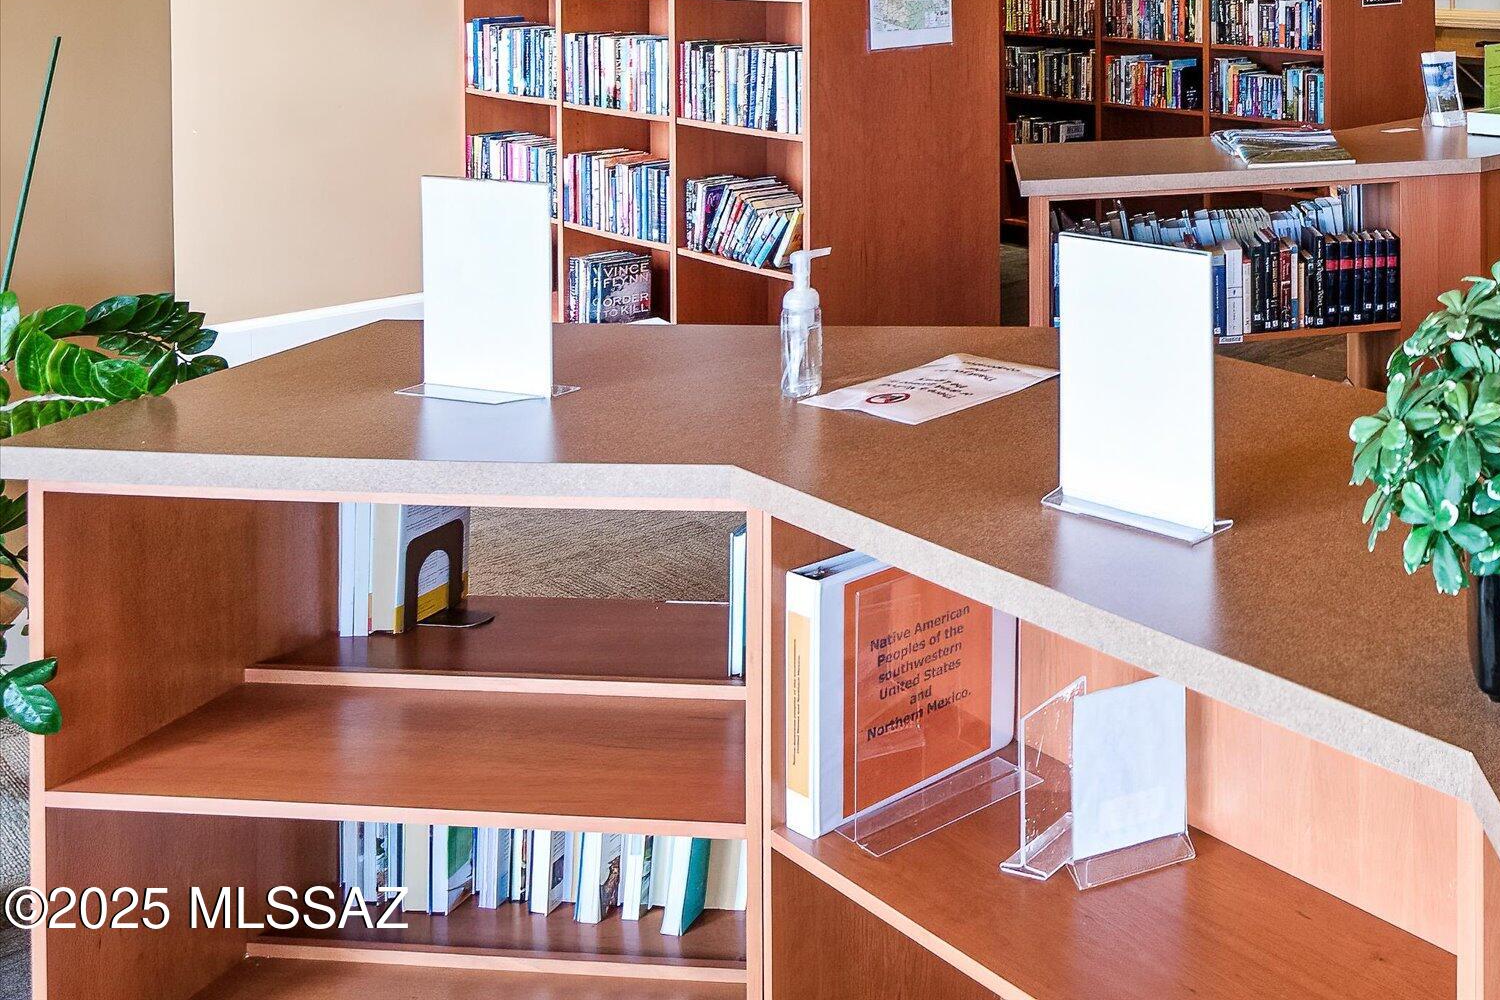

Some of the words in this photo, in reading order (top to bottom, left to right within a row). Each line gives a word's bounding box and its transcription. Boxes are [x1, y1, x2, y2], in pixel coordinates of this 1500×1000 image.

[603, 262, 650, 277] VINCE
[603, 273, 650, 288] FLYNN
[602, 292, 649, 307] ORDER
[604, 308, 618, 318] TO
[620, 303, 649, 316] KILL
[870, 628, 911, 652] Native
[914, 605, 971, 635] American
[877, 639, 926, 667] Peoples
[929, 631, 941, 646] of
[944, 625, 965, 640] the
[878, 641, 962, 684] southwestern
[879, 673, 920, 700] United
[924, 658, 961, 682] States
[909, 685, 932, 705] and
[867, 707, 924, 741] Northern
[927, 687, 972, 714] Mexico.
